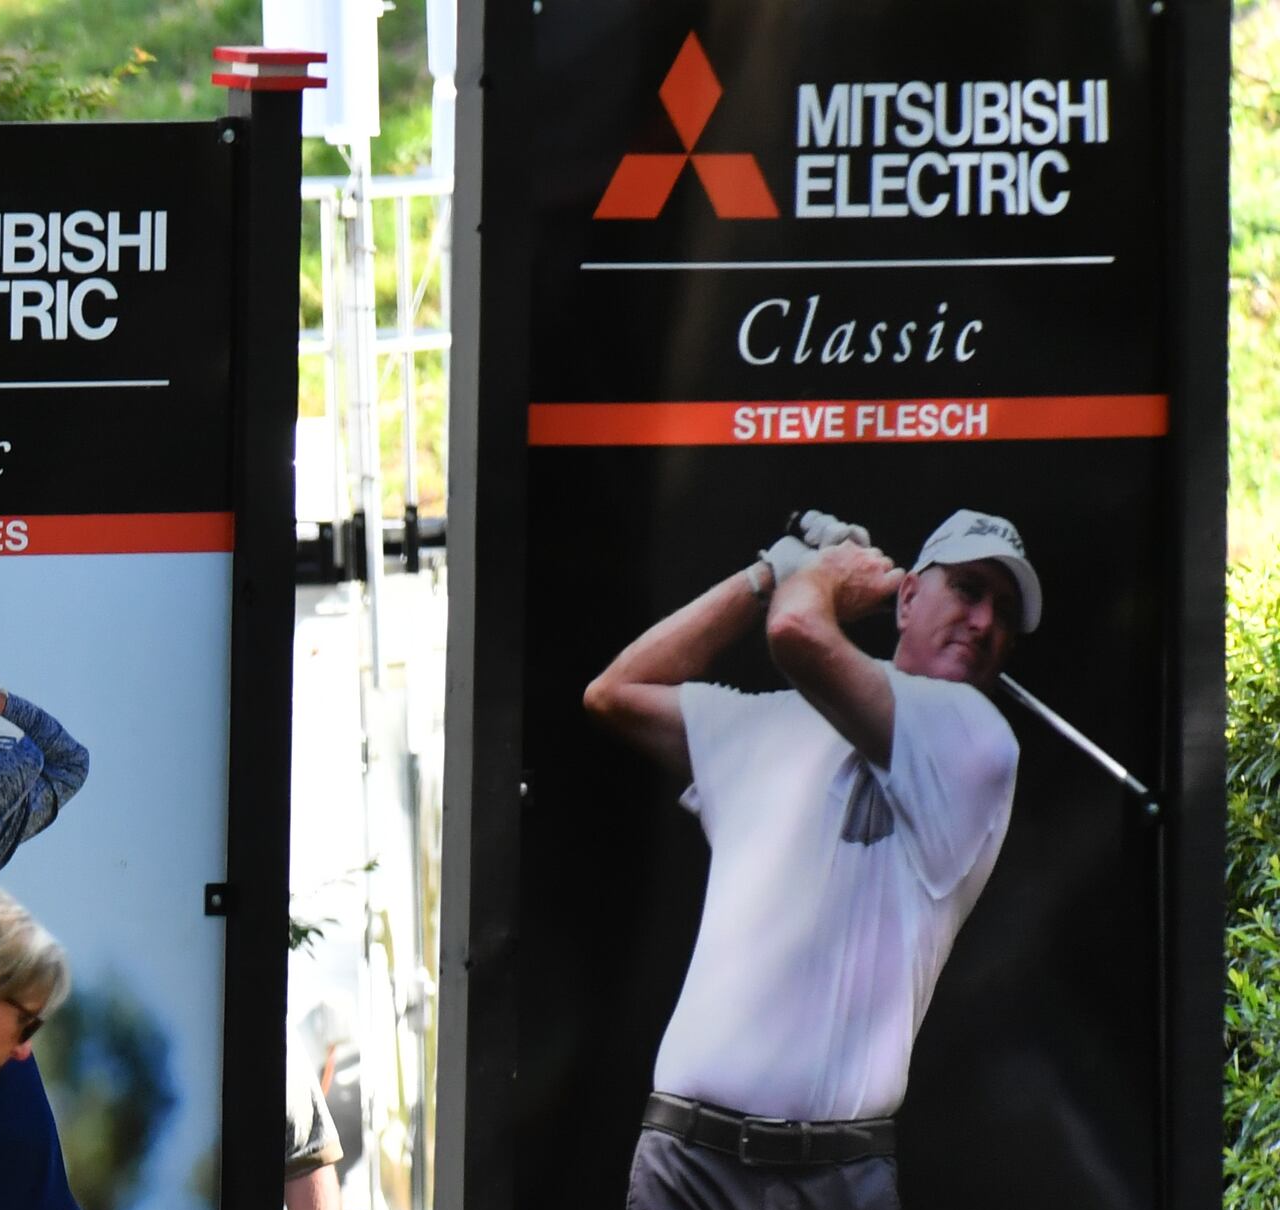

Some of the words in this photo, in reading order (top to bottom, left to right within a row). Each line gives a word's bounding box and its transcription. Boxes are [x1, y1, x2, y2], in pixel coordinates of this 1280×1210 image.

[796, 79, 1109, 148] MITSUBISHI
[795, 150, 1071, 219] ELECTRIC
[738, 295, 984, 366] Classic
[733, 405, 845, 441] STEVE
[856, 403, 988, 438] FLESCH
